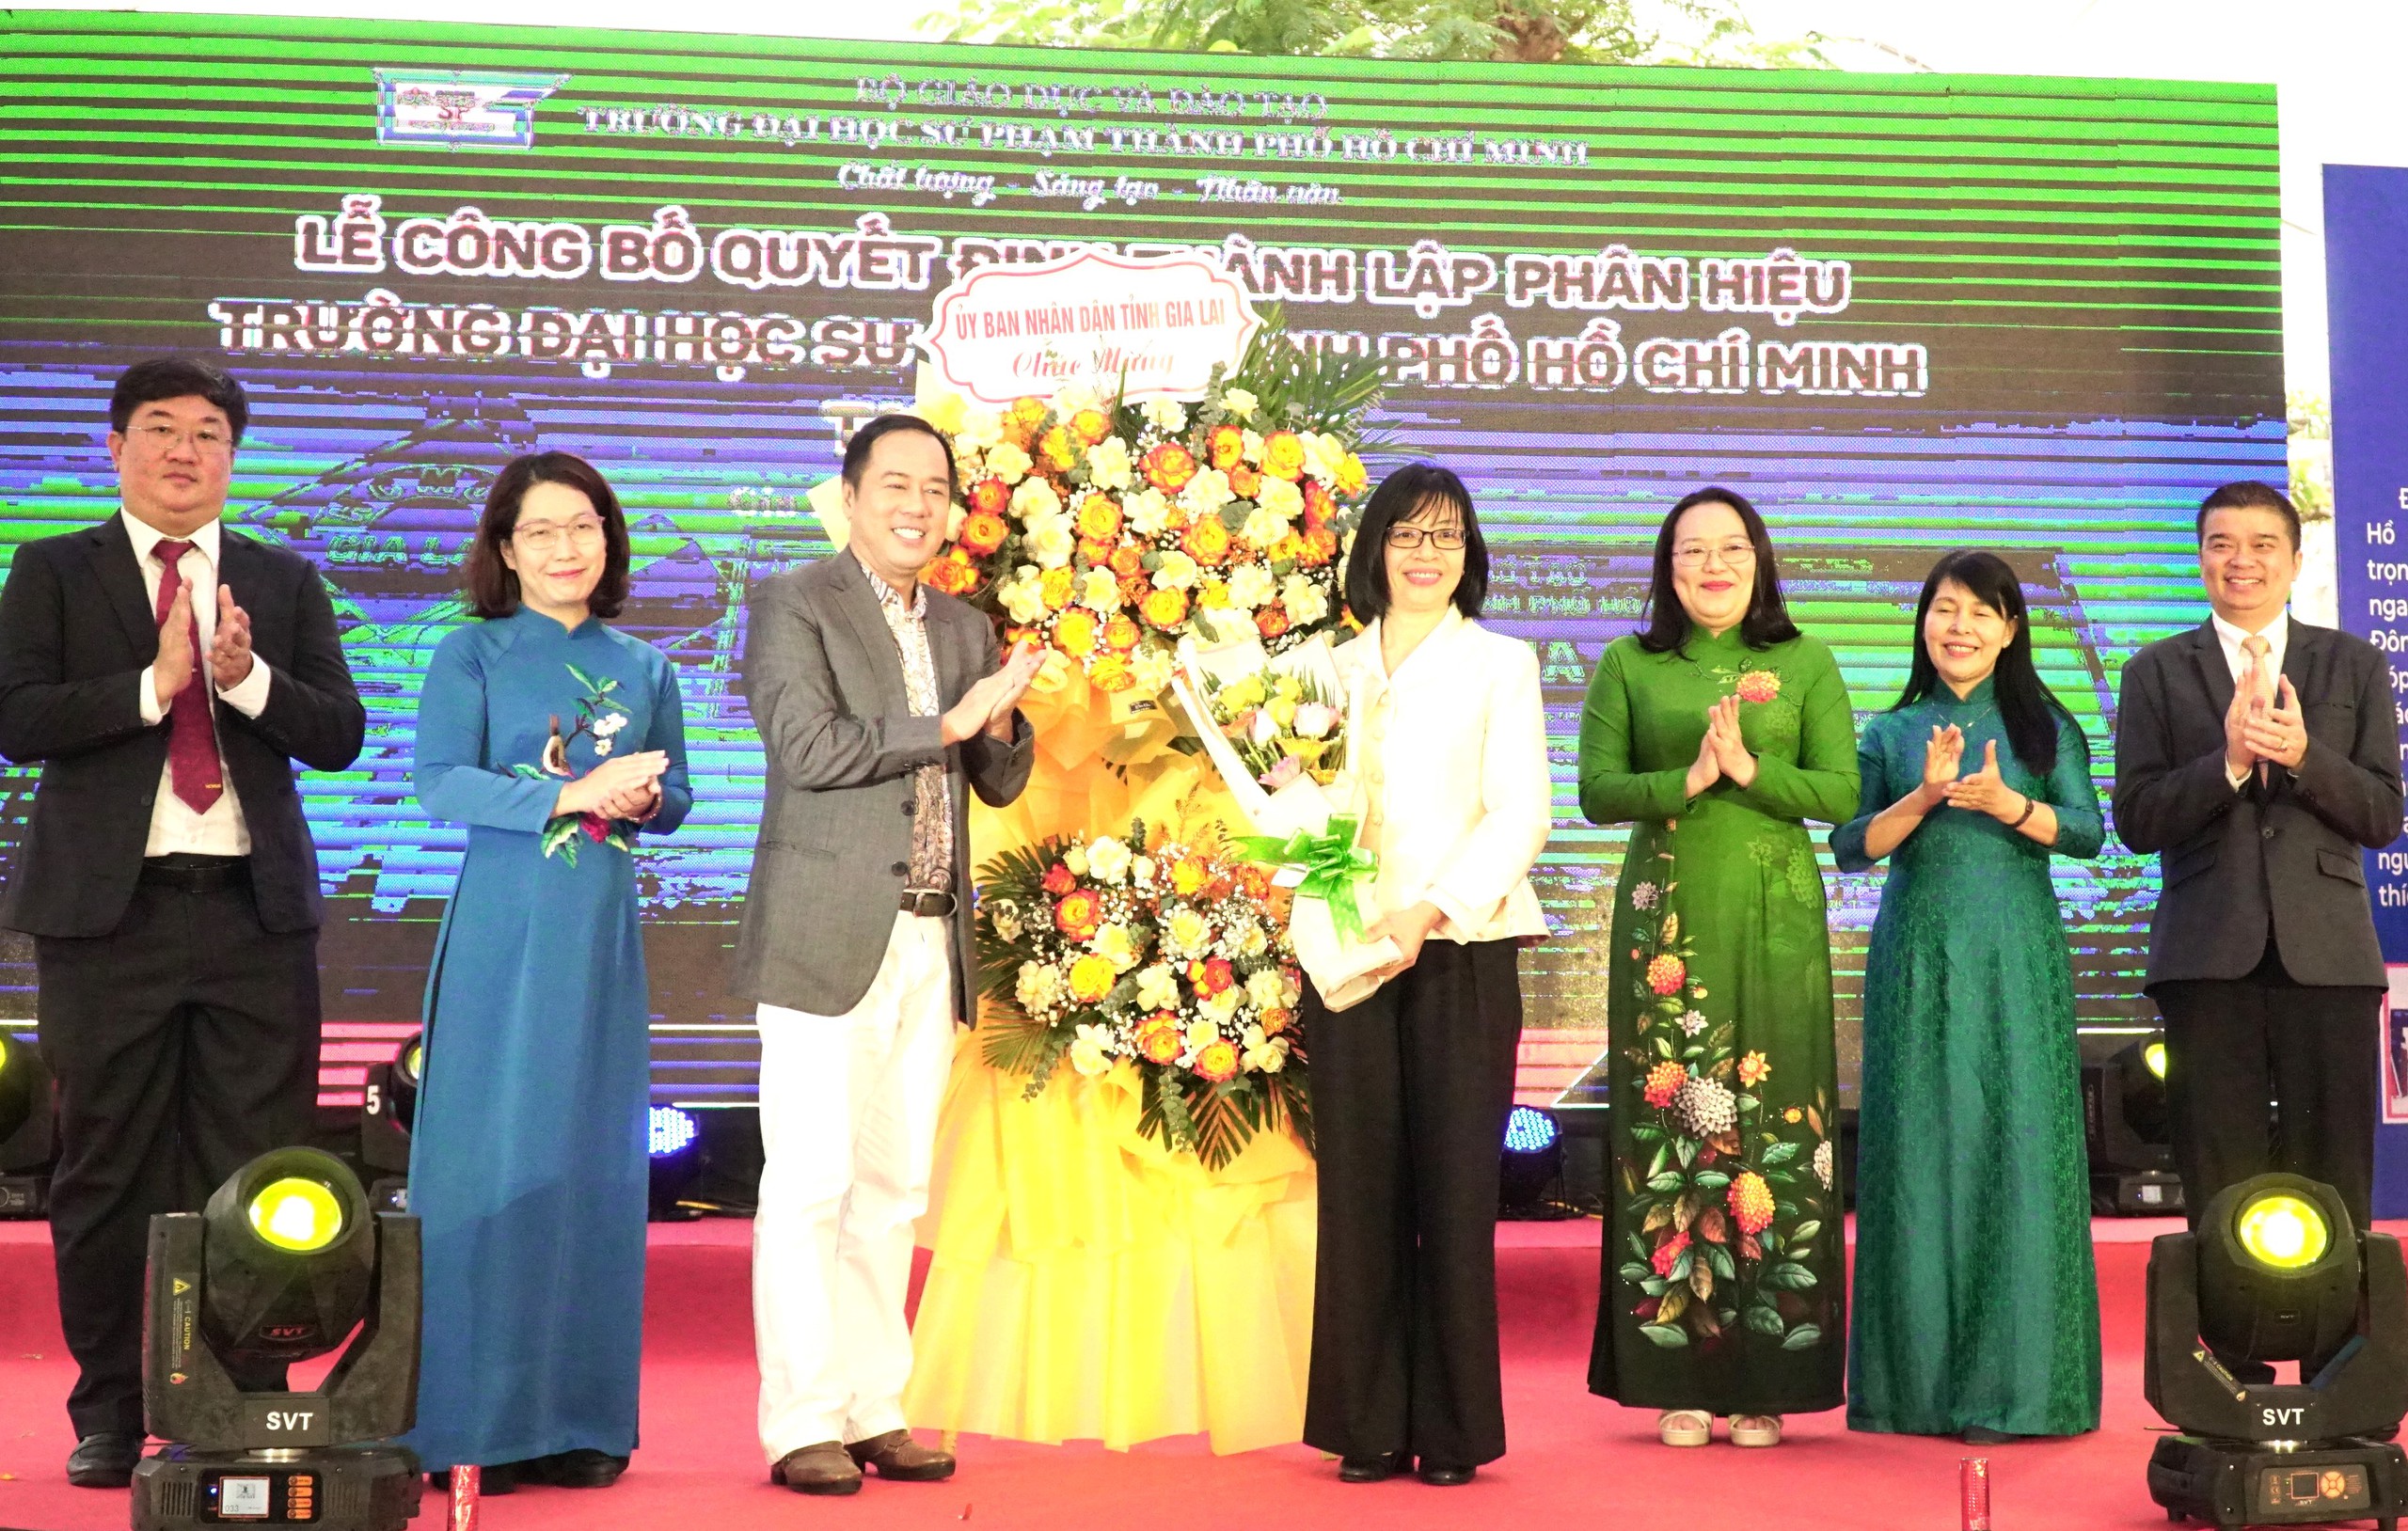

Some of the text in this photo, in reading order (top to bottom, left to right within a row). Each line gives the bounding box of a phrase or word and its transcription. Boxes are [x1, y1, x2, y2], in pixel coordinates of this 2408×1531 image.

[856, 72, 1328, 125] BỘ GIÁO DỤC VÀ ĐÀO TẠO
[578, 103, 1590, 166] TRƯỜNG ĐẠI HỌC SƯ PHẠM THÀNH PHỐ HỒ CHÍ MINH
[837, 159, 907, 190] Chất
[914, 162, 996, 207] lượng
[1031, 166, 1107, 210] Sáng
[1115, 175, 1160, 205] tạo
[295, 193, 386, 273] LỄ
[394, 205, 592, 279] CÔNG
[601, 205, 703, 281] BỐ
[712, 212, 942, 291] QUYẾT
[1126, 233, 1355, 303] ÀNH
[1366, 239, 1497, 320] LẬP
[1505, 244, 1689, 310] PHÂN
[1699, 246, 1852, 326] HIỆU
[956, 293, 1226, 339] ỦY BAN NHÂN DÂN TỈNH GIA LAI
[208, 289, 512, 360] TRƯỜNG
[518, 307, 646, 378] ĐẠI
[654, 309, 805, 382] HỌC
[811, 314, 925, 373] SƯ
[1378, 312, 1519, 388] PHỐ
[1527, 317, 1627, 392] HỒ
[1634, 327, 1751, 394] CHÍ
[1757, 341, 1928, 397] MINH
[420, 537, 479, 564] LA
[2367, 520, 2395, 545] Hồ
[2378, 883, 2408, 907] thí
[367, 1084, 380, 1115] 5
[266, 1413, 313, 1430] SVT
[2263, 1409, 2305, 1426] SVT
